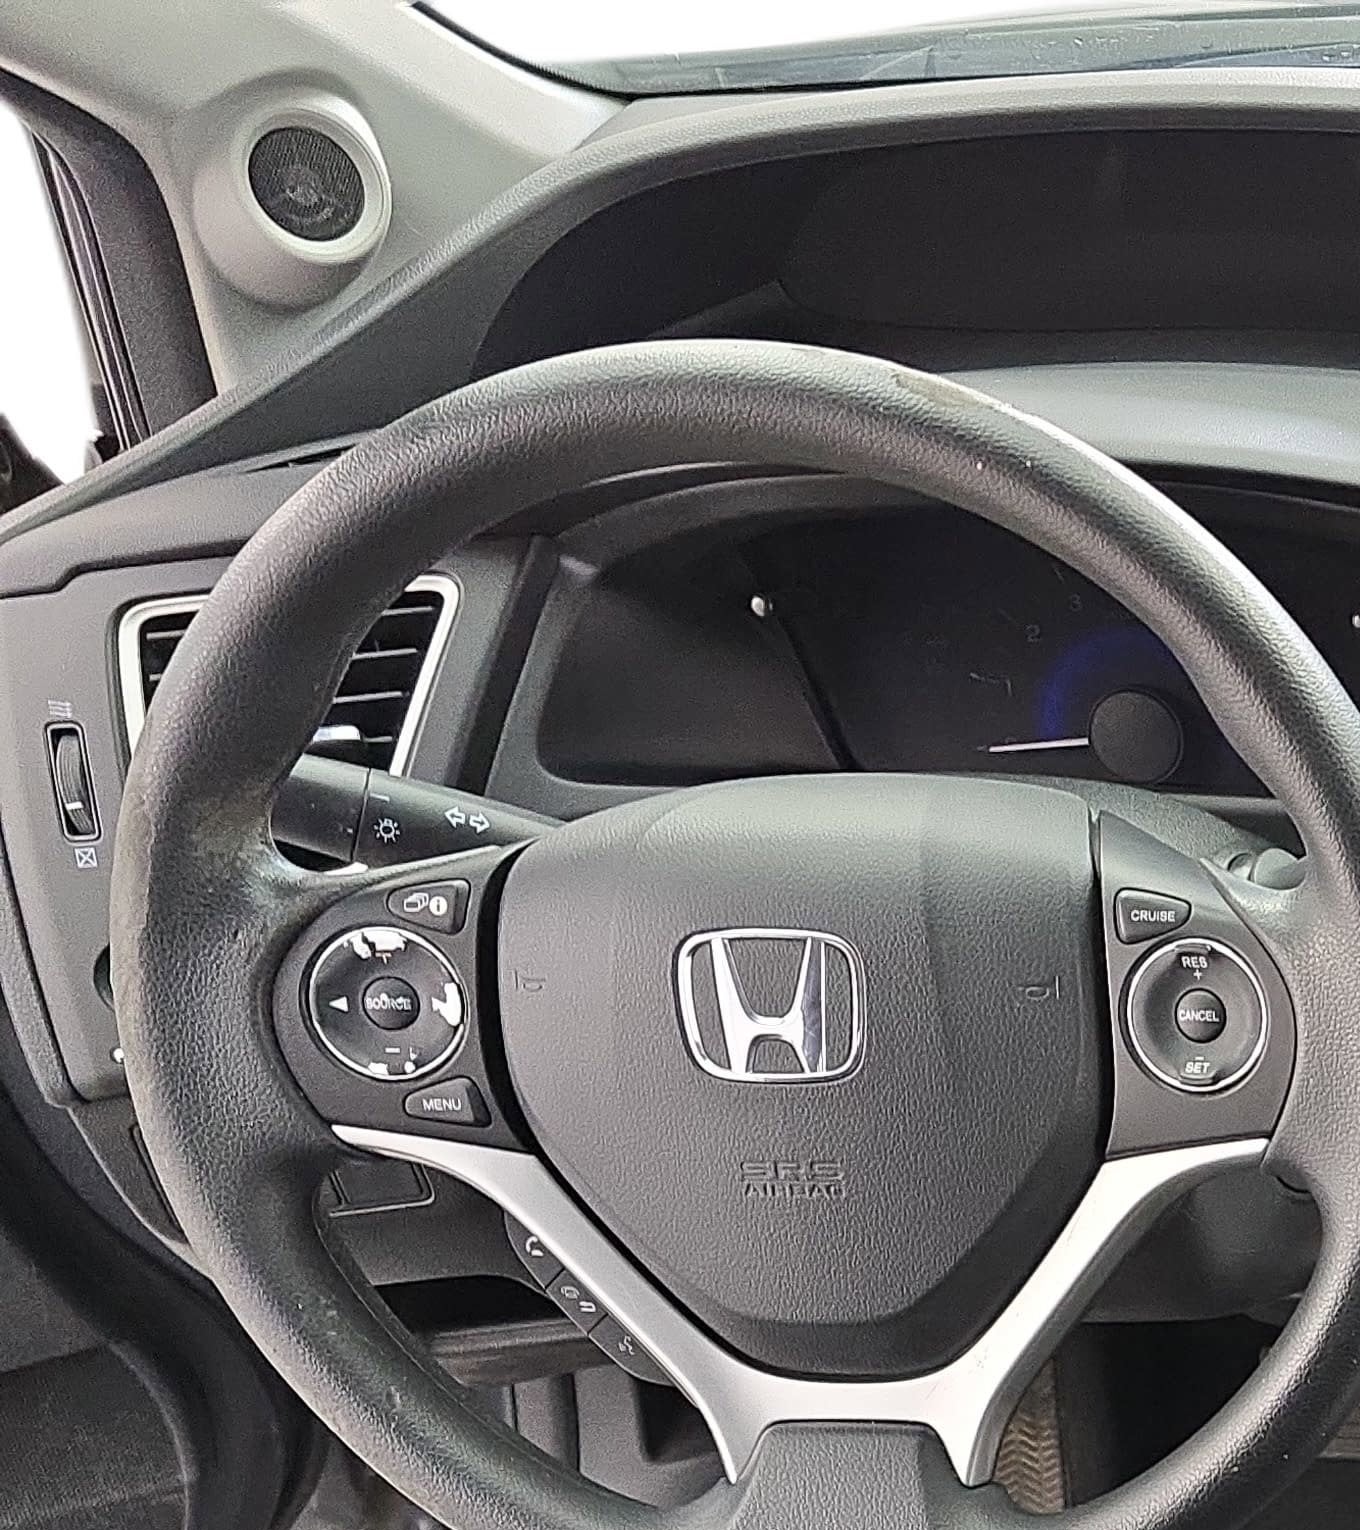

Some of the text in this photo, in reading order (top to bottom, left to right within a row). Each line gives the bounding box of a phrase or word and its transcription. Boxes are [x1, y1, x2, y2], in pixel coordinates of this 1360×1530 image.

[1130, 909, 1176, 923] CRUISE
[1181, 955, 1208, 969] RES
[1178, 1009, 1220, 1023] CANCEL
[1184, 1060, 1211, 1074] SET
[421, 1098, 462, 1112] MENU
